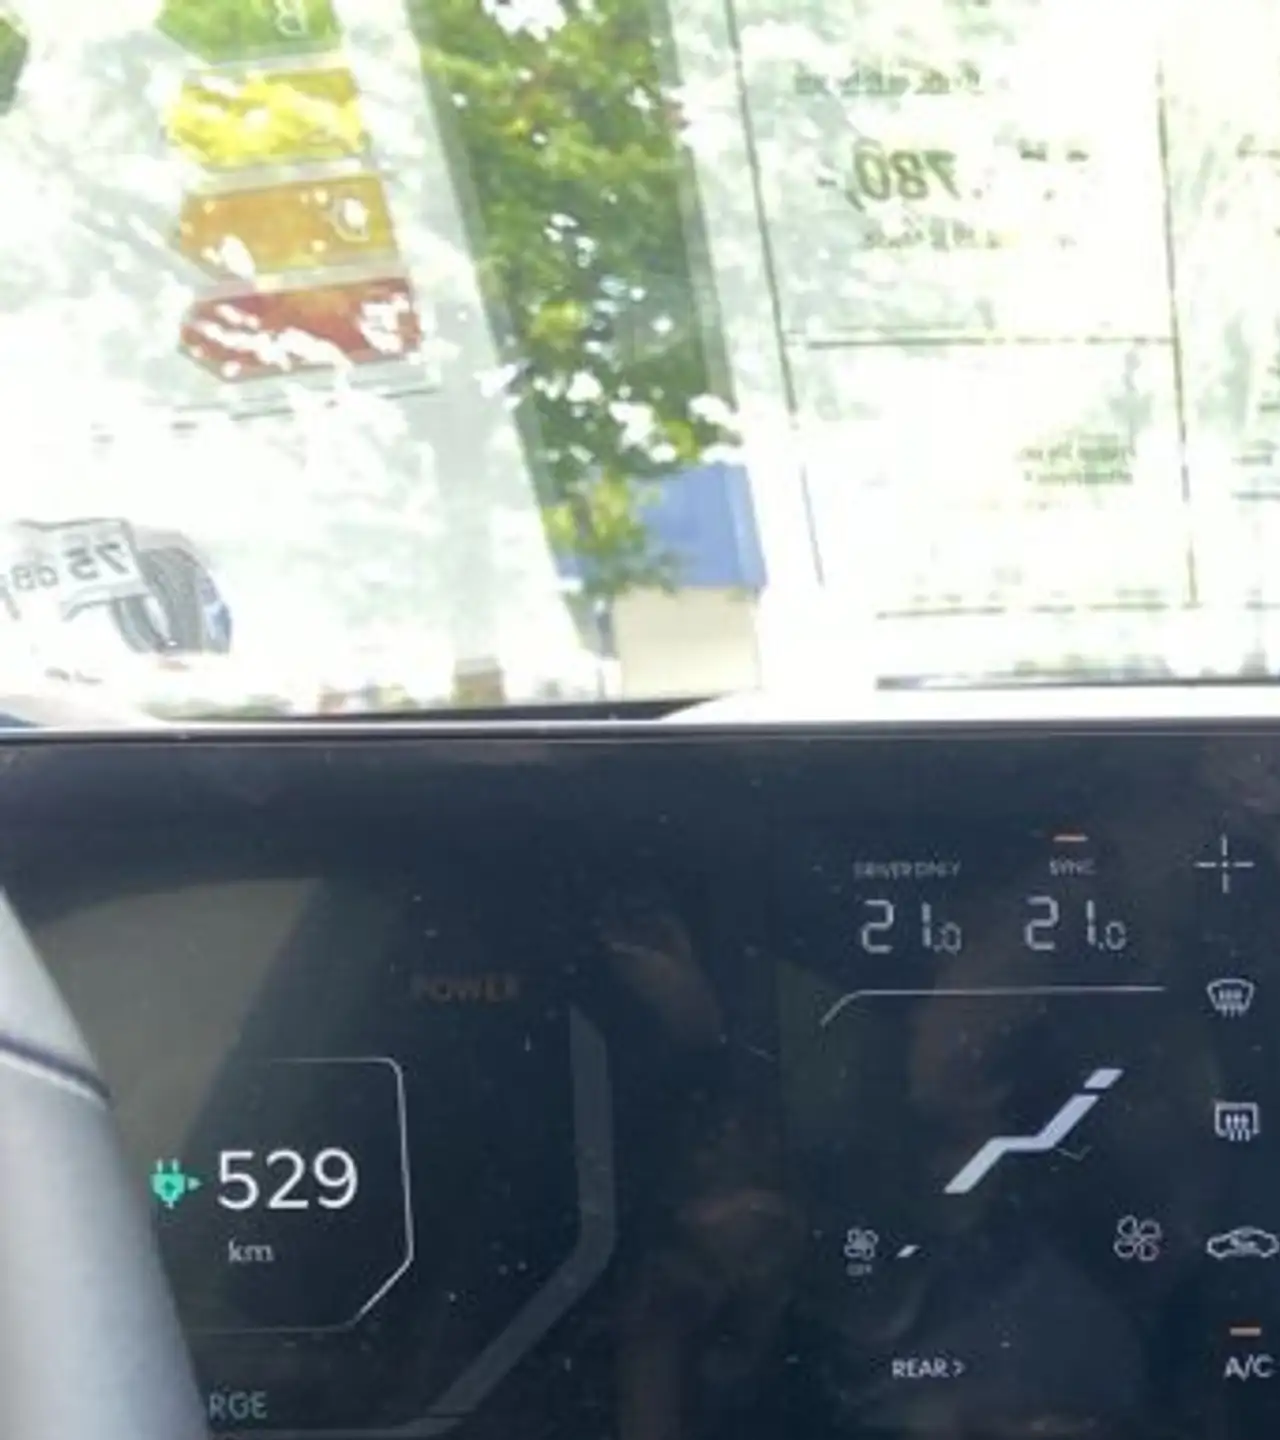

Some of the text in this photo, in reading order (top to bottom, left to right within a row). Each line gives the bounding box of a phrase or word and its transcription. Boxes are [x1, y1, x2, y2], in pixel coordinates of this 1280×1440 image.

[1023, 896, 1127, 951] 21.0
[216, 1147, 360, 1211] 529
[227, 1238, 274, 1264] km
[892, 1359, 949, 1379] REAR
[1224, 1356, 1275, 1382] A/C
[208, 1390, 270, 1419] RGE
